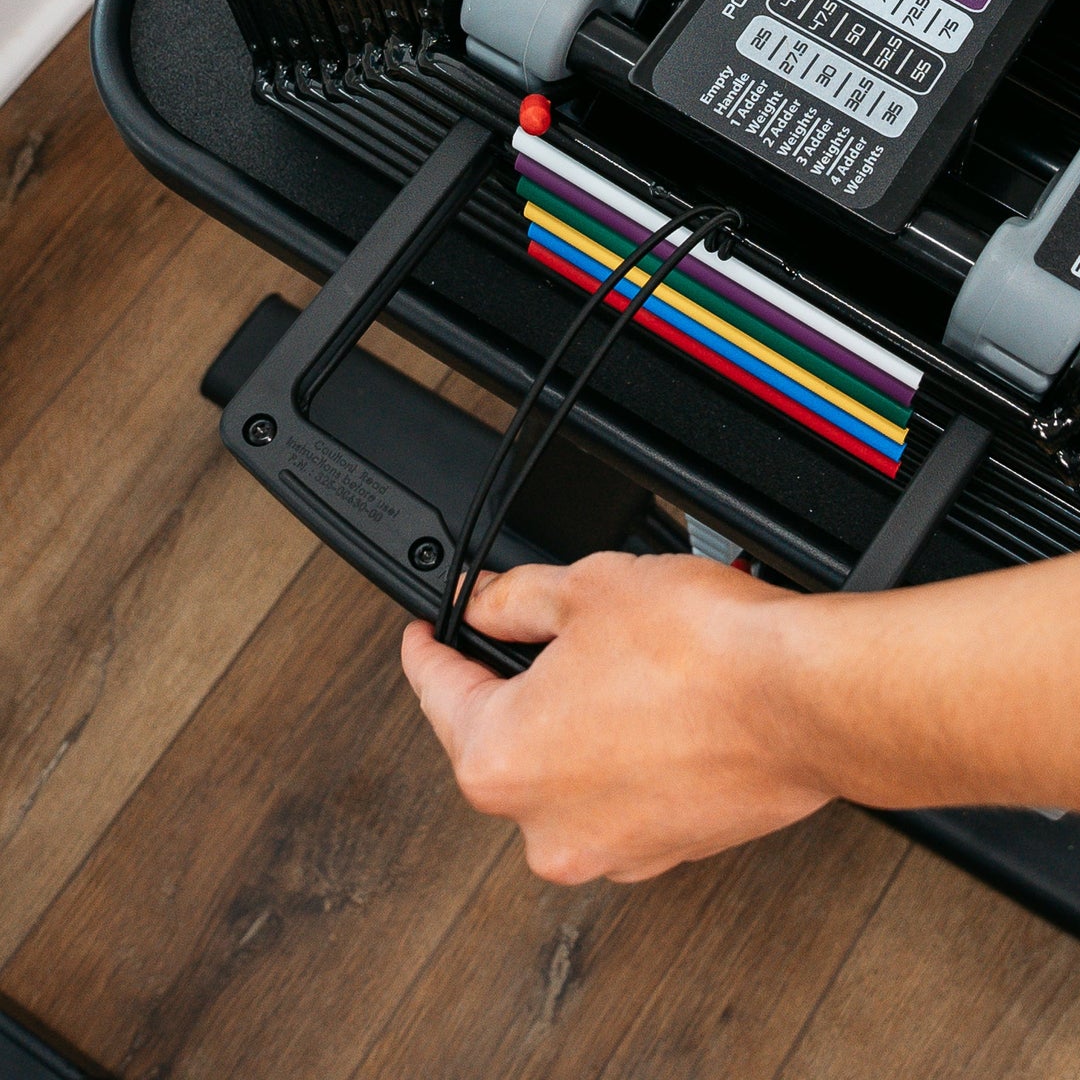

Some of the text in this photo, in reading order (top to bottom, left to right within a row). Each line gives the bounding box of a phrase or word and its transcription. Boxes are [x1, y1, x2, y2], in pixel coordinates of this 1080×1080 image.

[749, 27, 772, 50] 25
[778, 40, 809, 74] 27.5
[808, 0, 838, 32] 47.5
[815, 64, 837, 87] 30
[844, 23, 866, 46] 50
[700, 65, 735, 106] Empty
[713, 72, 750, 116] Handle
[844, 77, 874, 112] 32.5
[873, 35, 903, 70] 52.5
[881, 101, 904, 125] 35
[910, 59, 932, 83] 55
[938, 19, 960, 39] 75
[729, 79, 769, 127] 1 Adder
[745, 90, 784, 136] Weight
[762, 98, 801, 148] 2 Adder
[776, 106, 818, 157] Weights
[796, 118, 835, 167] 3 Adder
[810, 125, 851, 177] Weights
[830, 136, 868, 186] 4 Adder
[843, 144, 885, 196] Weights
